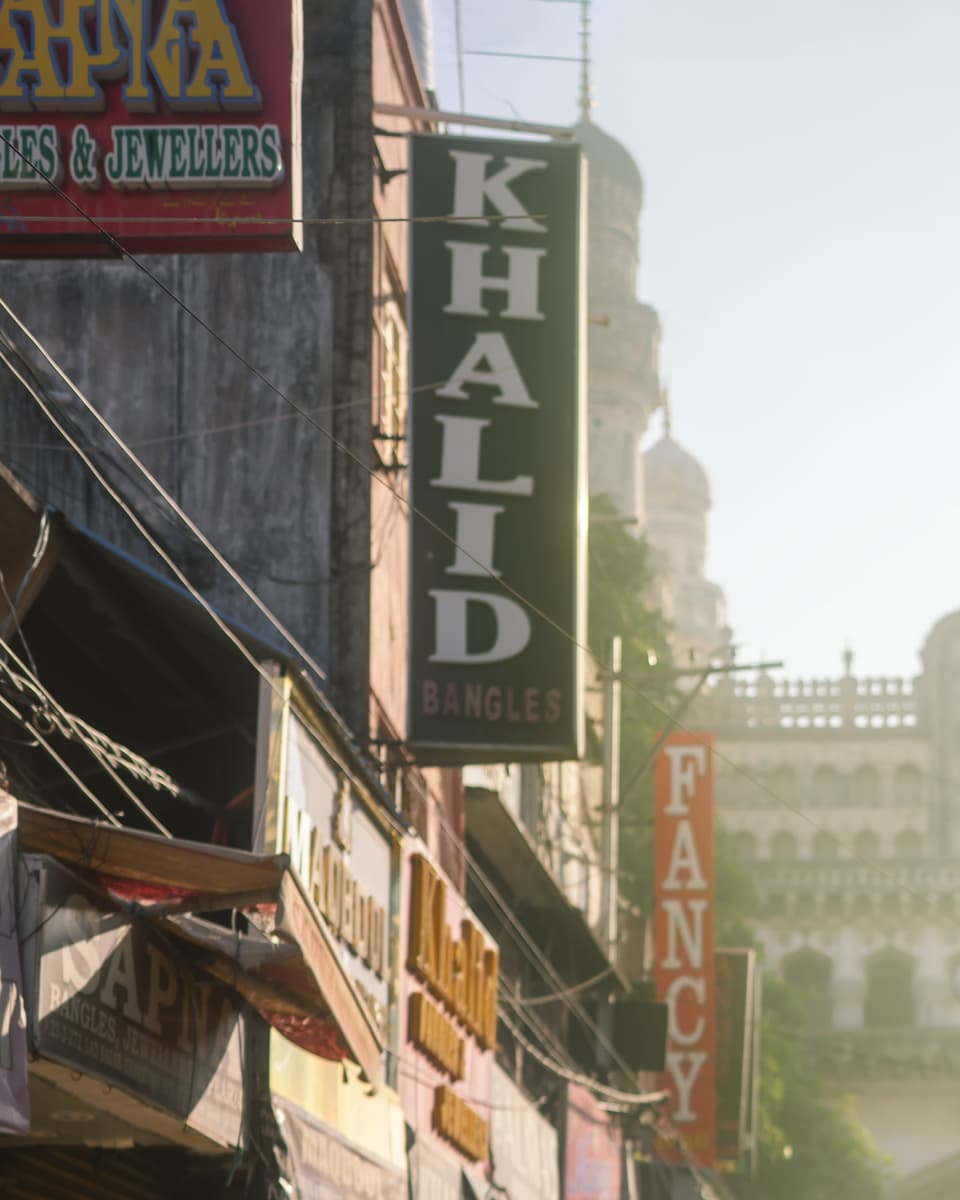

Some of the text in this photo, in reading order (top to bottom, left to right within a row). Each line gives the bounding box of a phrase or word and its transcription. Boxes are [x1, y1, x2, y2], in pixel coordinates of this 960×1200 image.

[0, 0, 259, 101] APNA
[70, 125, 96, 183] &
[105, 125, 282, 182] JEWELLERS
[429, 149, 548, 665] KHALID
[421, 680, 561, 724] BANGLES
[661, 745, 708, 1123] FANCY
